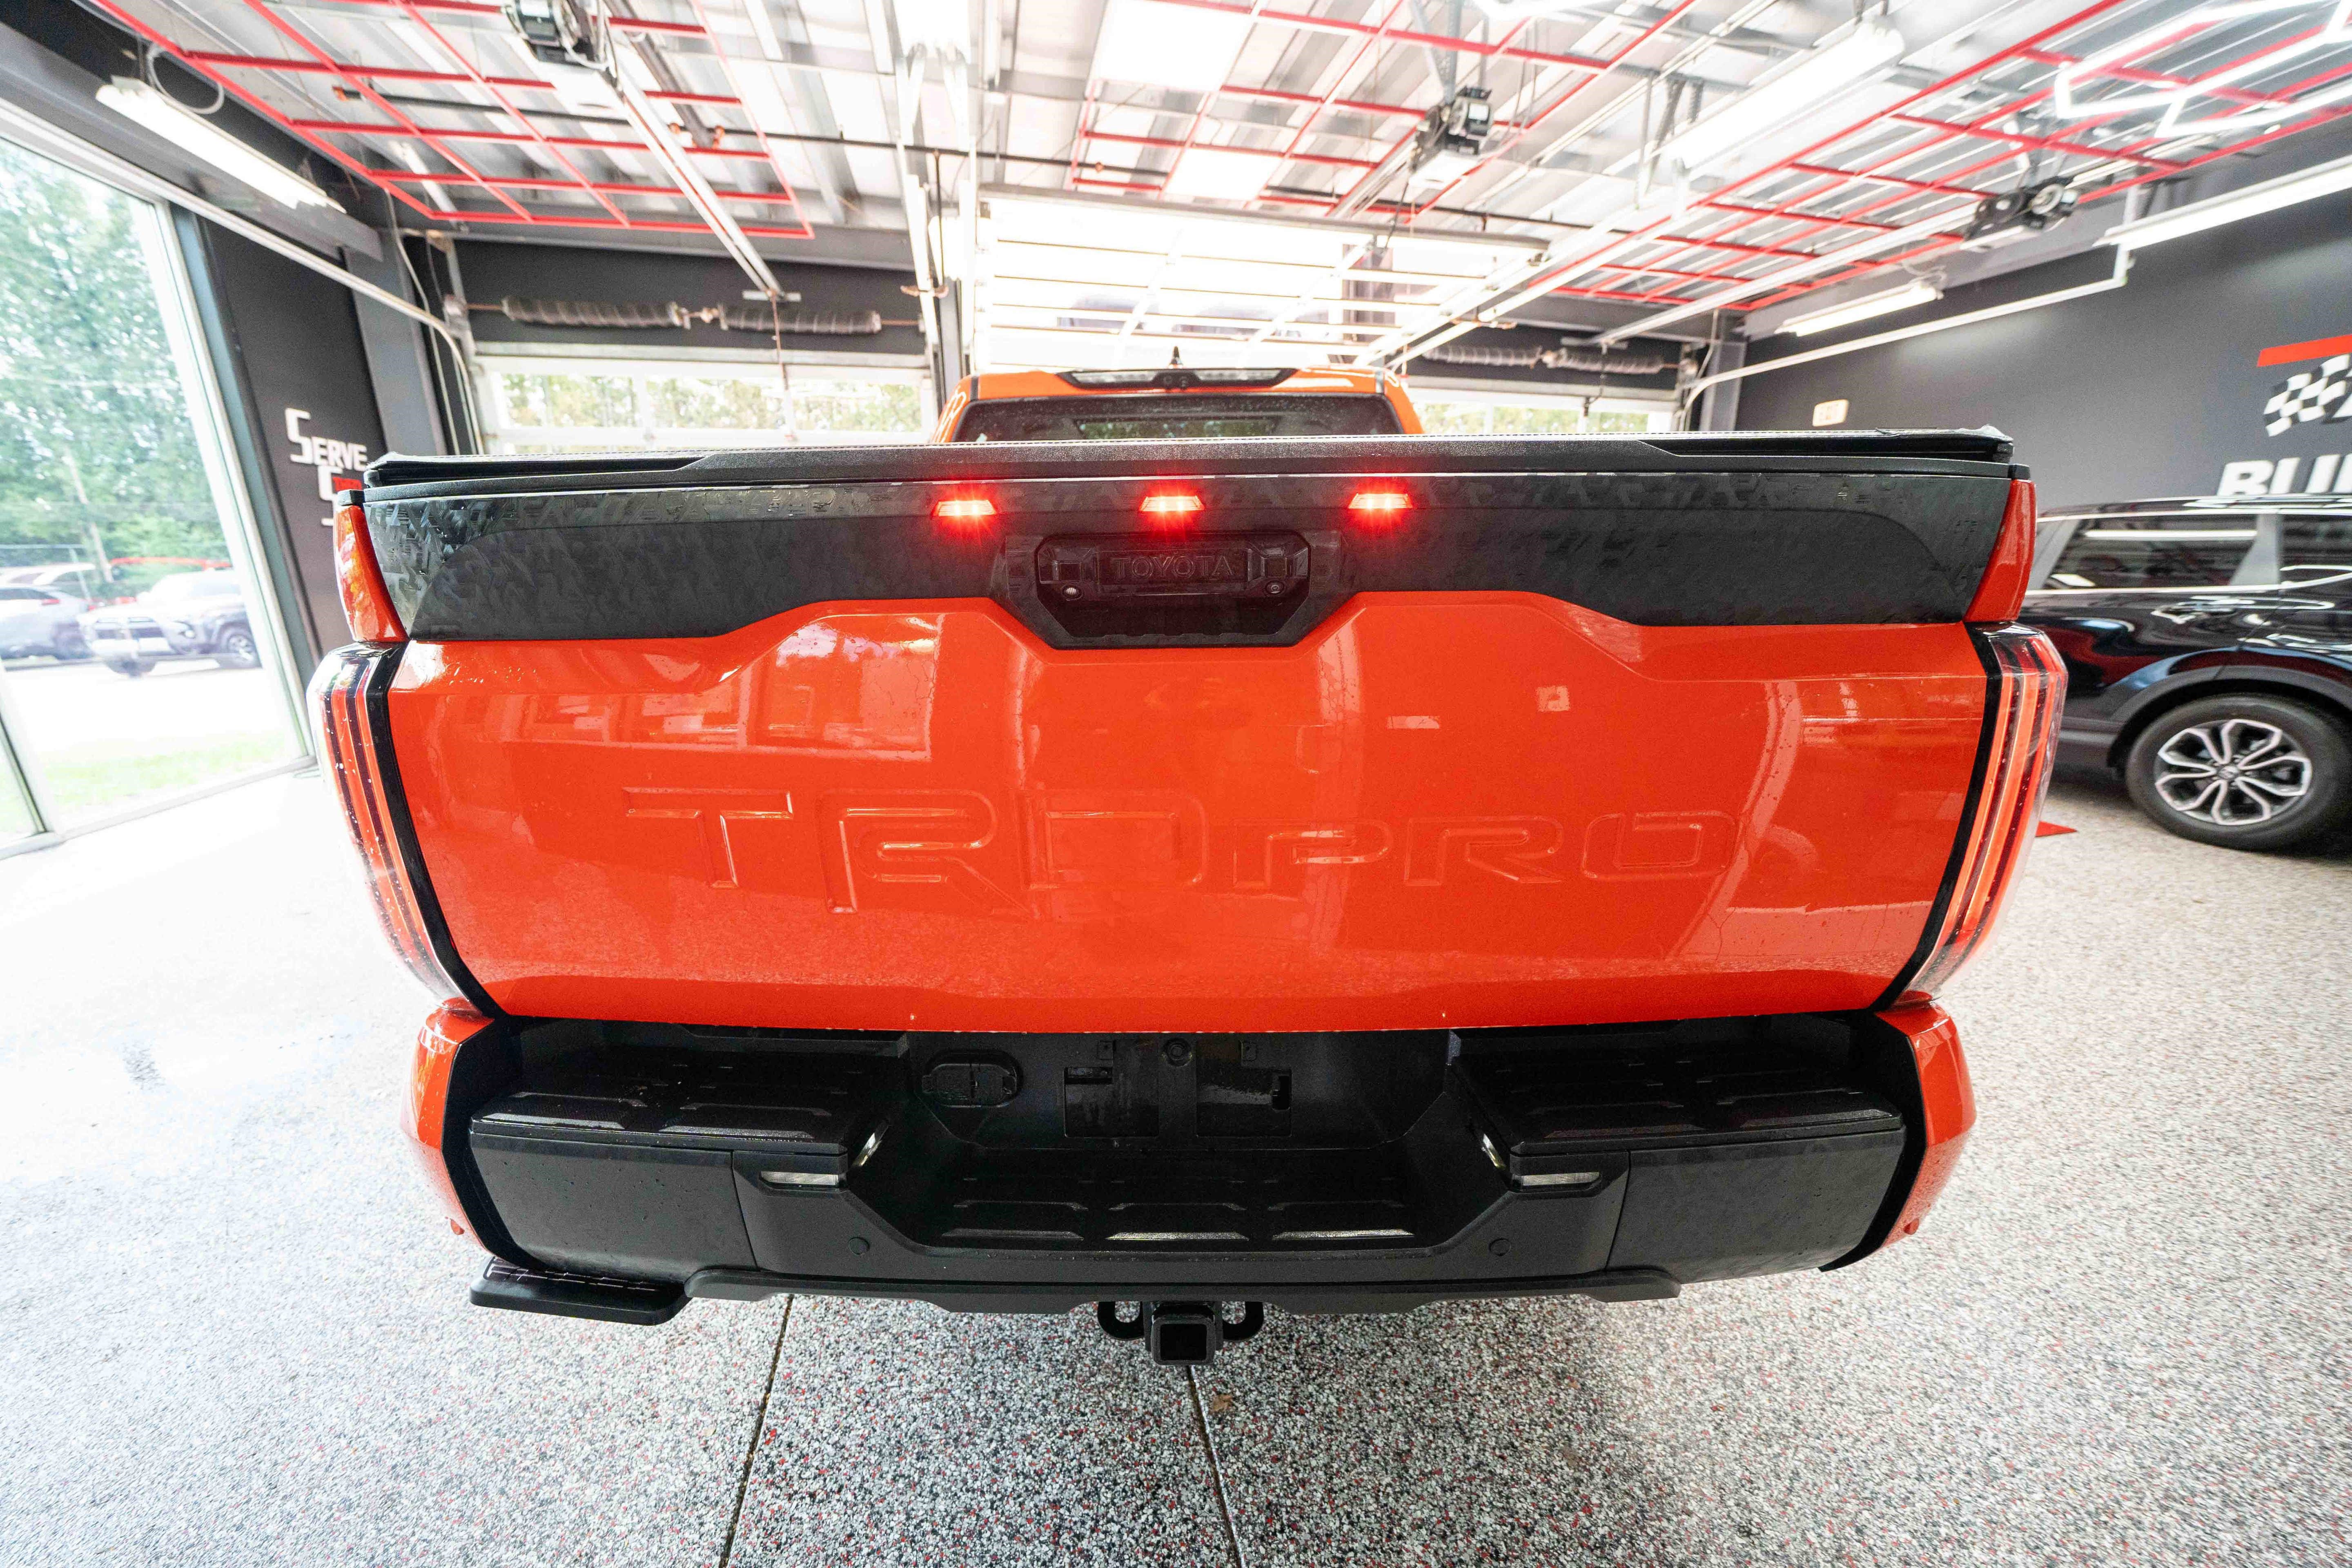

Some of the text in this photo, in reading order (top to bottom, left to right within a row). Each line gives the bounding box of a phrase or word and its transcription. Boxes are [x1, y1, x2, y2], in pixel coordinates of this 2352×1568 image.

[1111, 555, 1235, 579] TOYOTA
[621, 785, 1736, 921] TRD PRO
